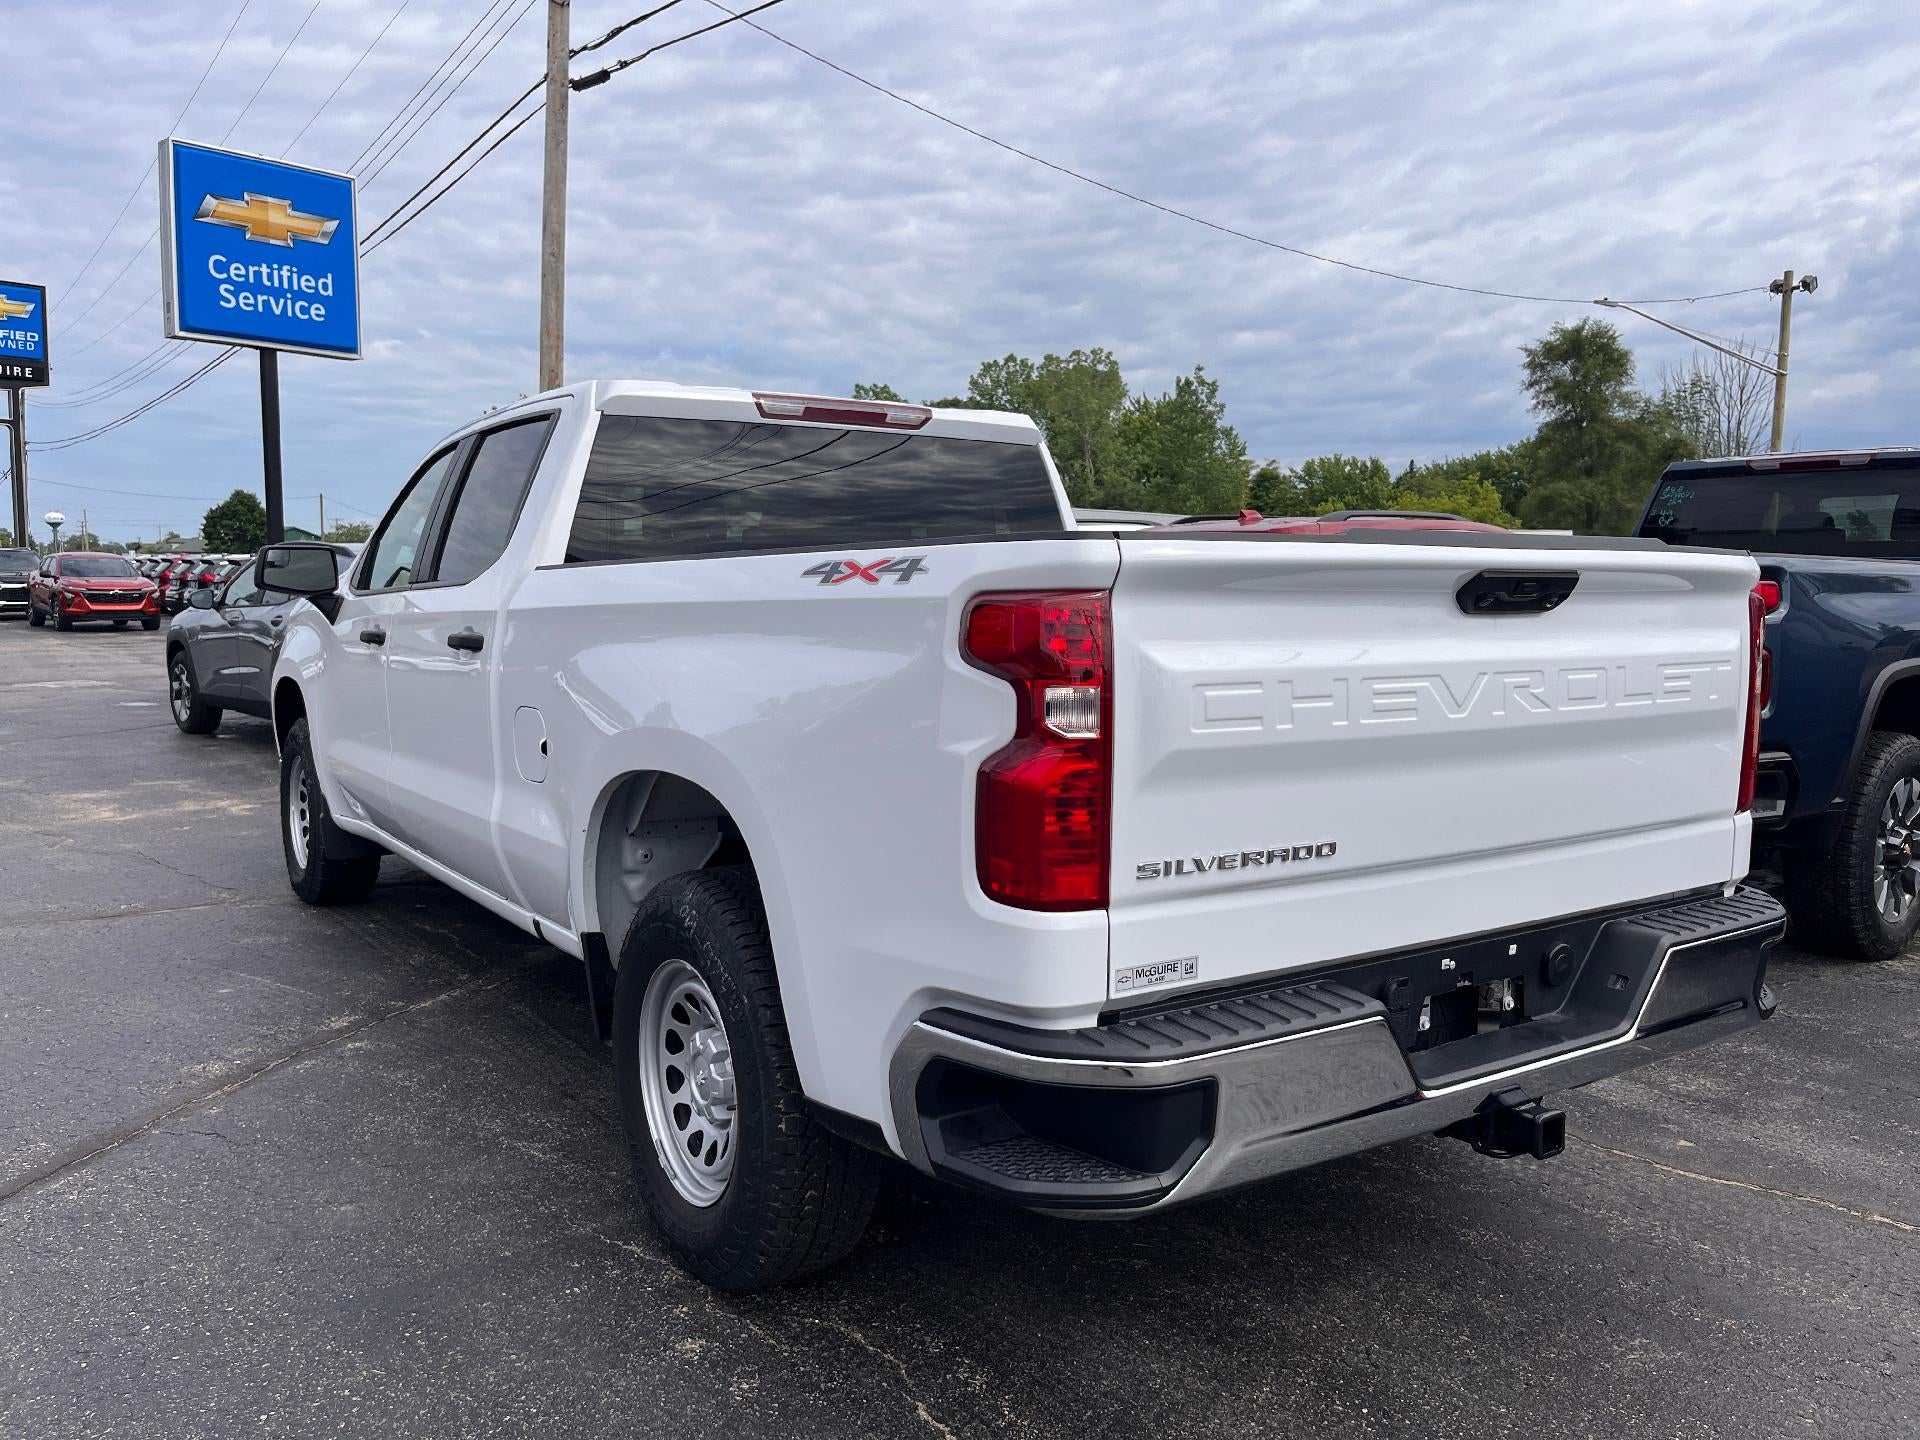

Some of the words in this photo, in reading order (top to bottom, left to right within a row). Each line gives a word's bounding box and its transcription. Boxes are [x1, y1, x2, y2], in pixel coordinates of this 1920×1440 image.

[208, 254, 333, 297] Certified
[219, 283, 326, 322] Service
[0, 329, 39, 341] FIED
[1191, 659, 1732, 732] CHEVROLET
[1136, 840, 1337, 880] SILVERADO
